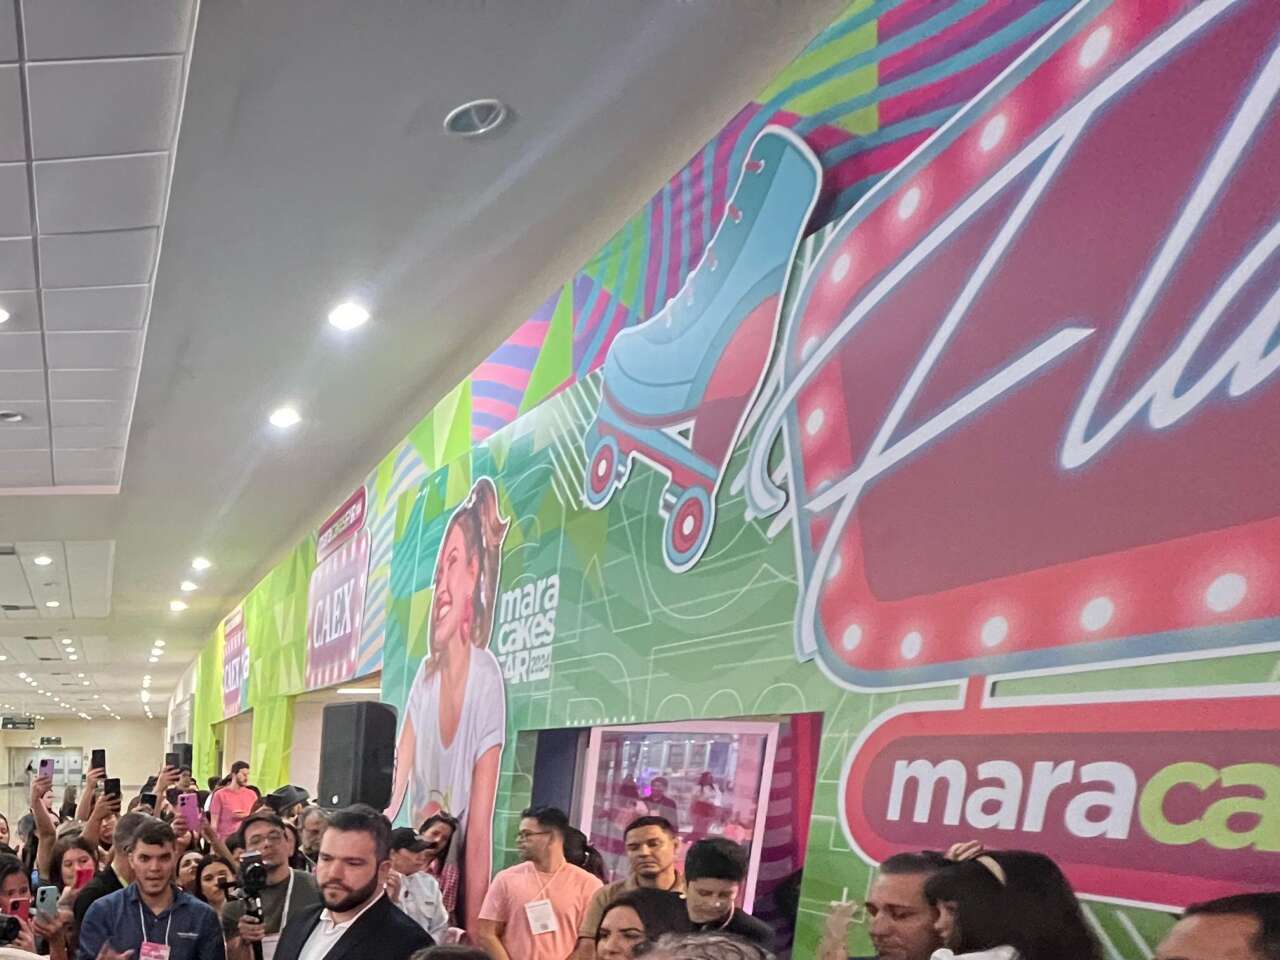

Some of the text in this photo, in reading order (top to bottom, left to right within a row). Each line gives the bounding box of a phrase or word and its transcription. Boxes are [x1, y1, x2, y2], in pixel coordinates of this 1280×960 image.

[313, 577, 355, 648] CAEX
[499, 574, 560, 623] mara
[497, 609, 556, 654] cakes
